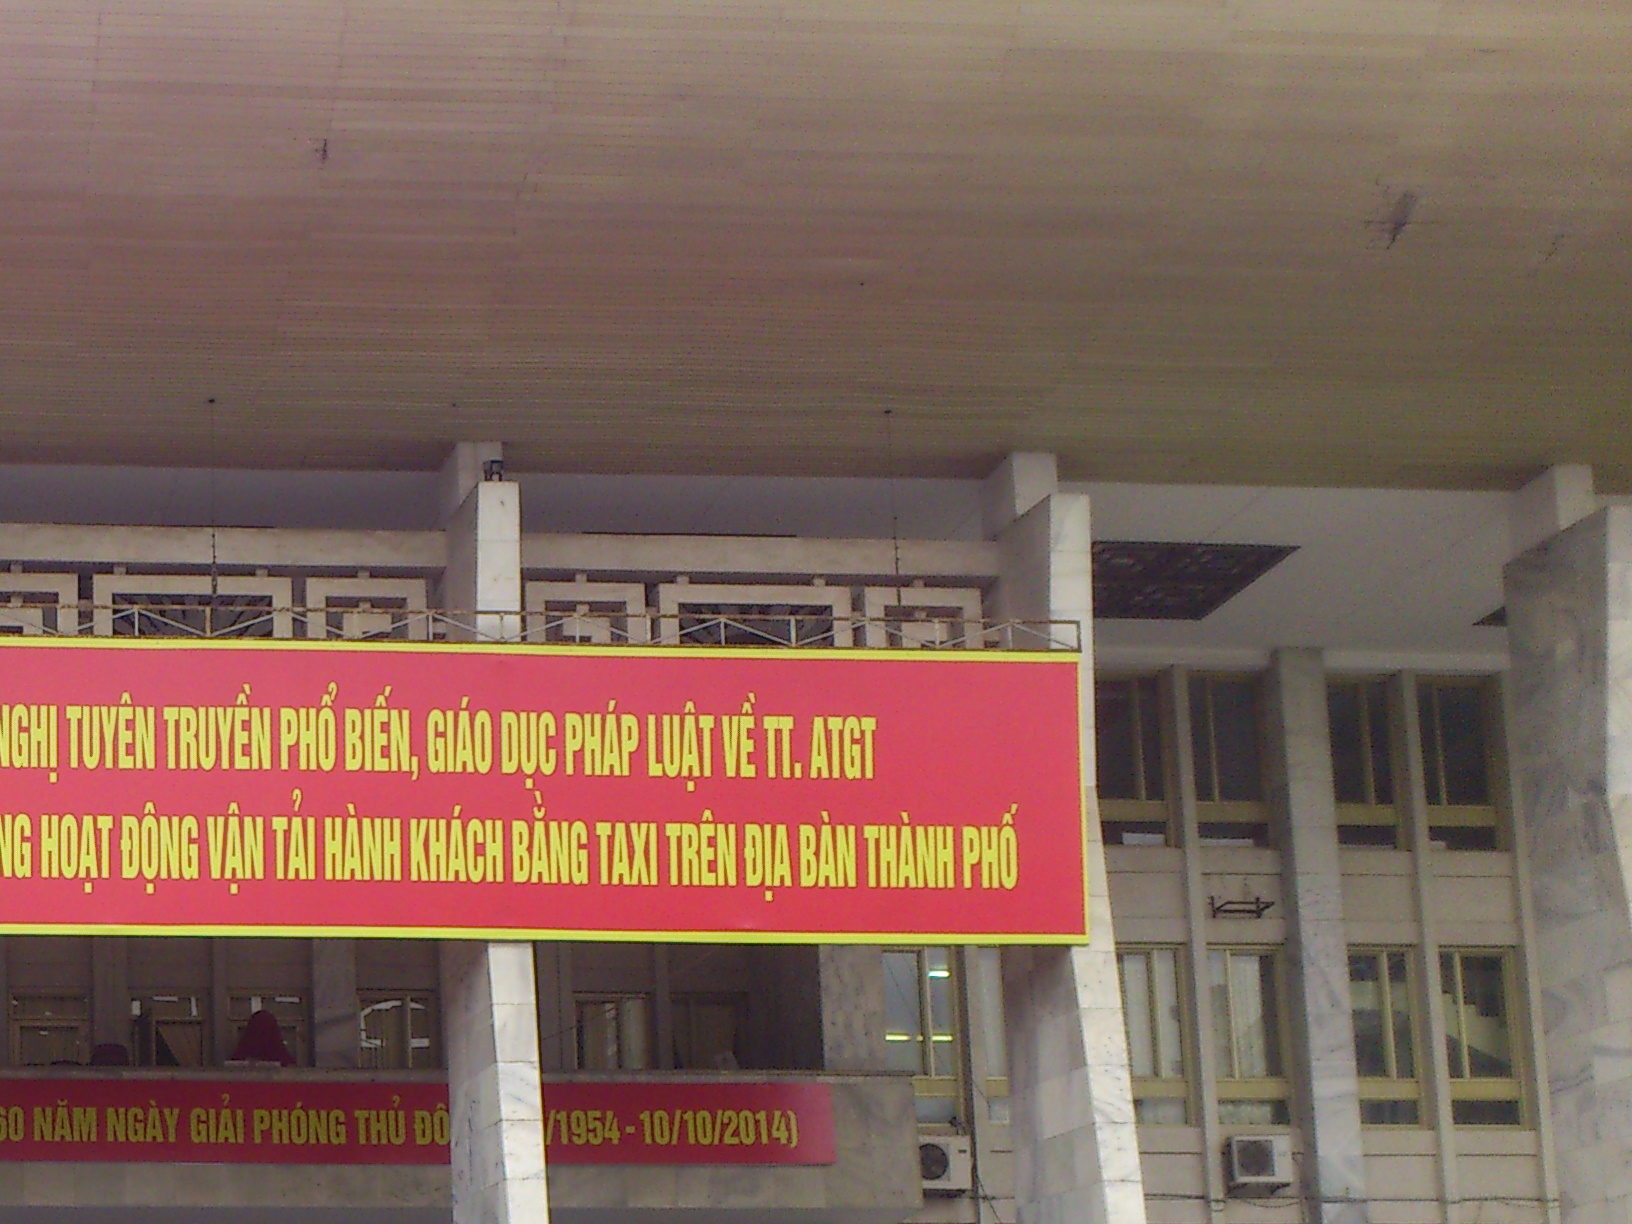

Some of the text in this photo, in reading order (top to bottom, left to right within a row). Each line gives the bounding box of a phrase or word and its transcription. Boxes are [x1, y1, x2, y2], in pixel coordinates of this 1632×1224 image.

[66, 692, 155, 769] TUYÊN
[163, 684, 271, 770] TRUYỀN
[280, 682, 337, 771] PHỔ
[344, 686, 418, 780] BIẾN,
[427, 696, 492, 774] GIÁO
[501, 711, 556, 789] DỤC
[564, 700, 639, 776] PHÁP
[647, 701, 714, 791] LUẬT
[721, 693, 756, 777] VỀ
[763, 716, 802, 778] TT.
[810, 716, 876, 779] ATGT
[41, 814, 113, 893] HOẠT
[120, 802, 199, 894] ĐỘNG
[206, 802, 264, 894] VẬN
[272, 789, 315, 880] TẢI
[324, 803, 401, 881] HÀNH
[410, 805, 504, 883] KHÁCH
[512, 791, 588, 885] BẰNG
[595, 822, 658, 885] TAXI
[665, 809, 737, 886] TRÊN
[744, 824, 792, 901] ĐỊA
[799, 811, 856, 887] BÀN
[863, 812, 955, 888] THÀNH
[962, 804, 1018, 889] PHỐ
[34, 1102, 96, 1141] NĂM
[108, 1101, 178, 1142] NGÀY
[191, 1095, 243, 1143] GIẢI
[254, 1104, 345, 1144] PHÓNG
[355, 1096, 405, 1144] THỦ
[414, 1104, 449, 1144] ĐÔ
[640, 1110, 798, 1148] 10/10/2014)
